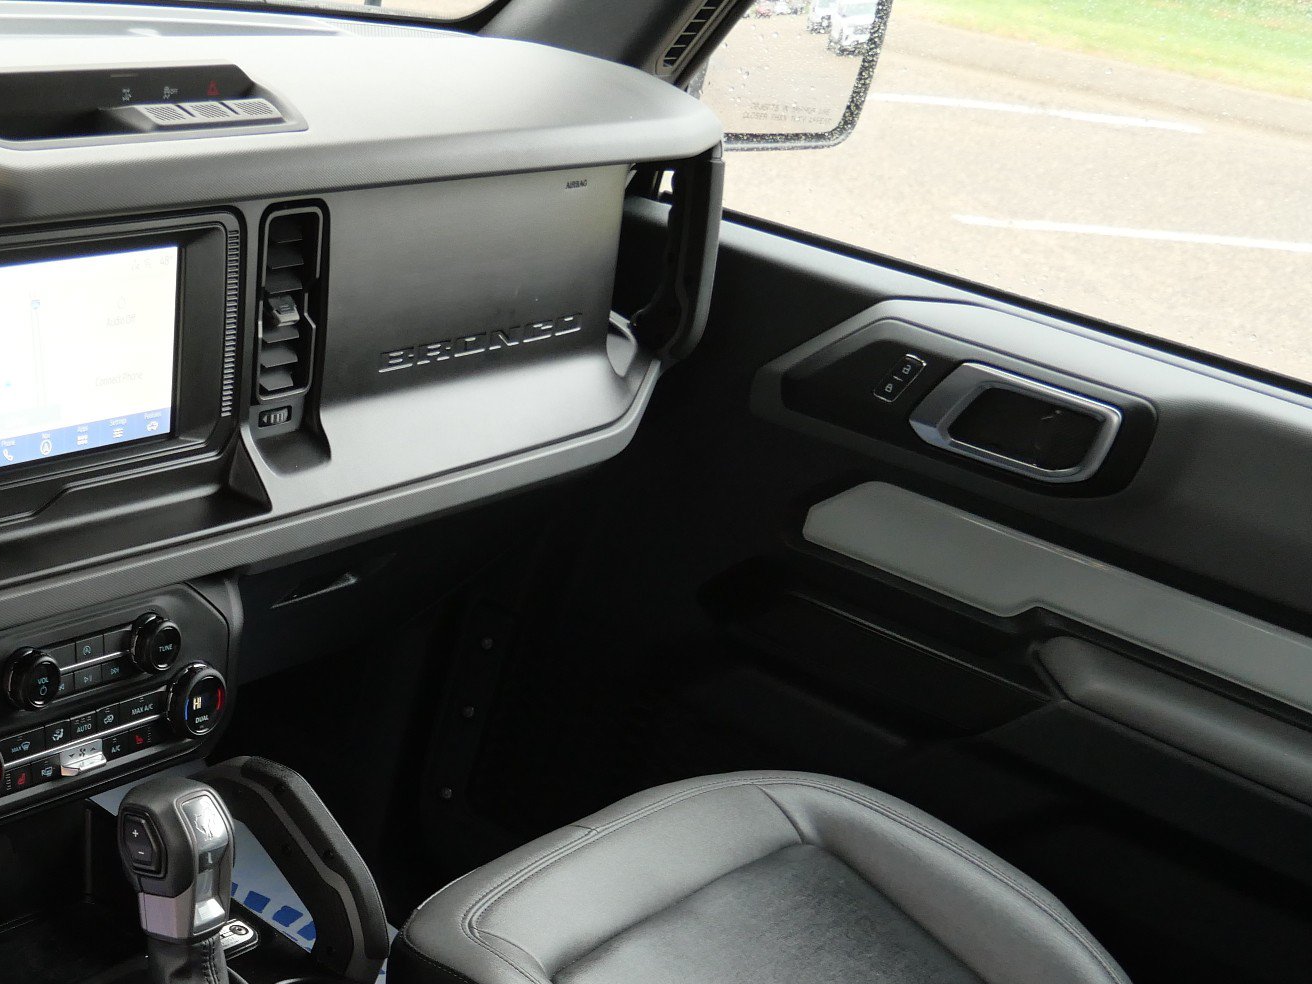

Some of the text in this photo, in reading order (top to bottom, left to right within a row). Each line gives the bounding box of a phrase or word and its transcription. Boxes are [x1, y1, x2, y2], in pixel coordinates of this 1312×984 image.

[378, 313, 582, 373] BRONCO
[159, 643, 173, 653] TUNE
[37, 676, 49, 685] VOL
[193, 696, 202, 711] HI
[131, 703, 154, 716] MAX A/C
[195, 714, 209, 724] DUAL
[76, 723, 92, 733] AUTO
[111, 745, 121, 754] A/C
